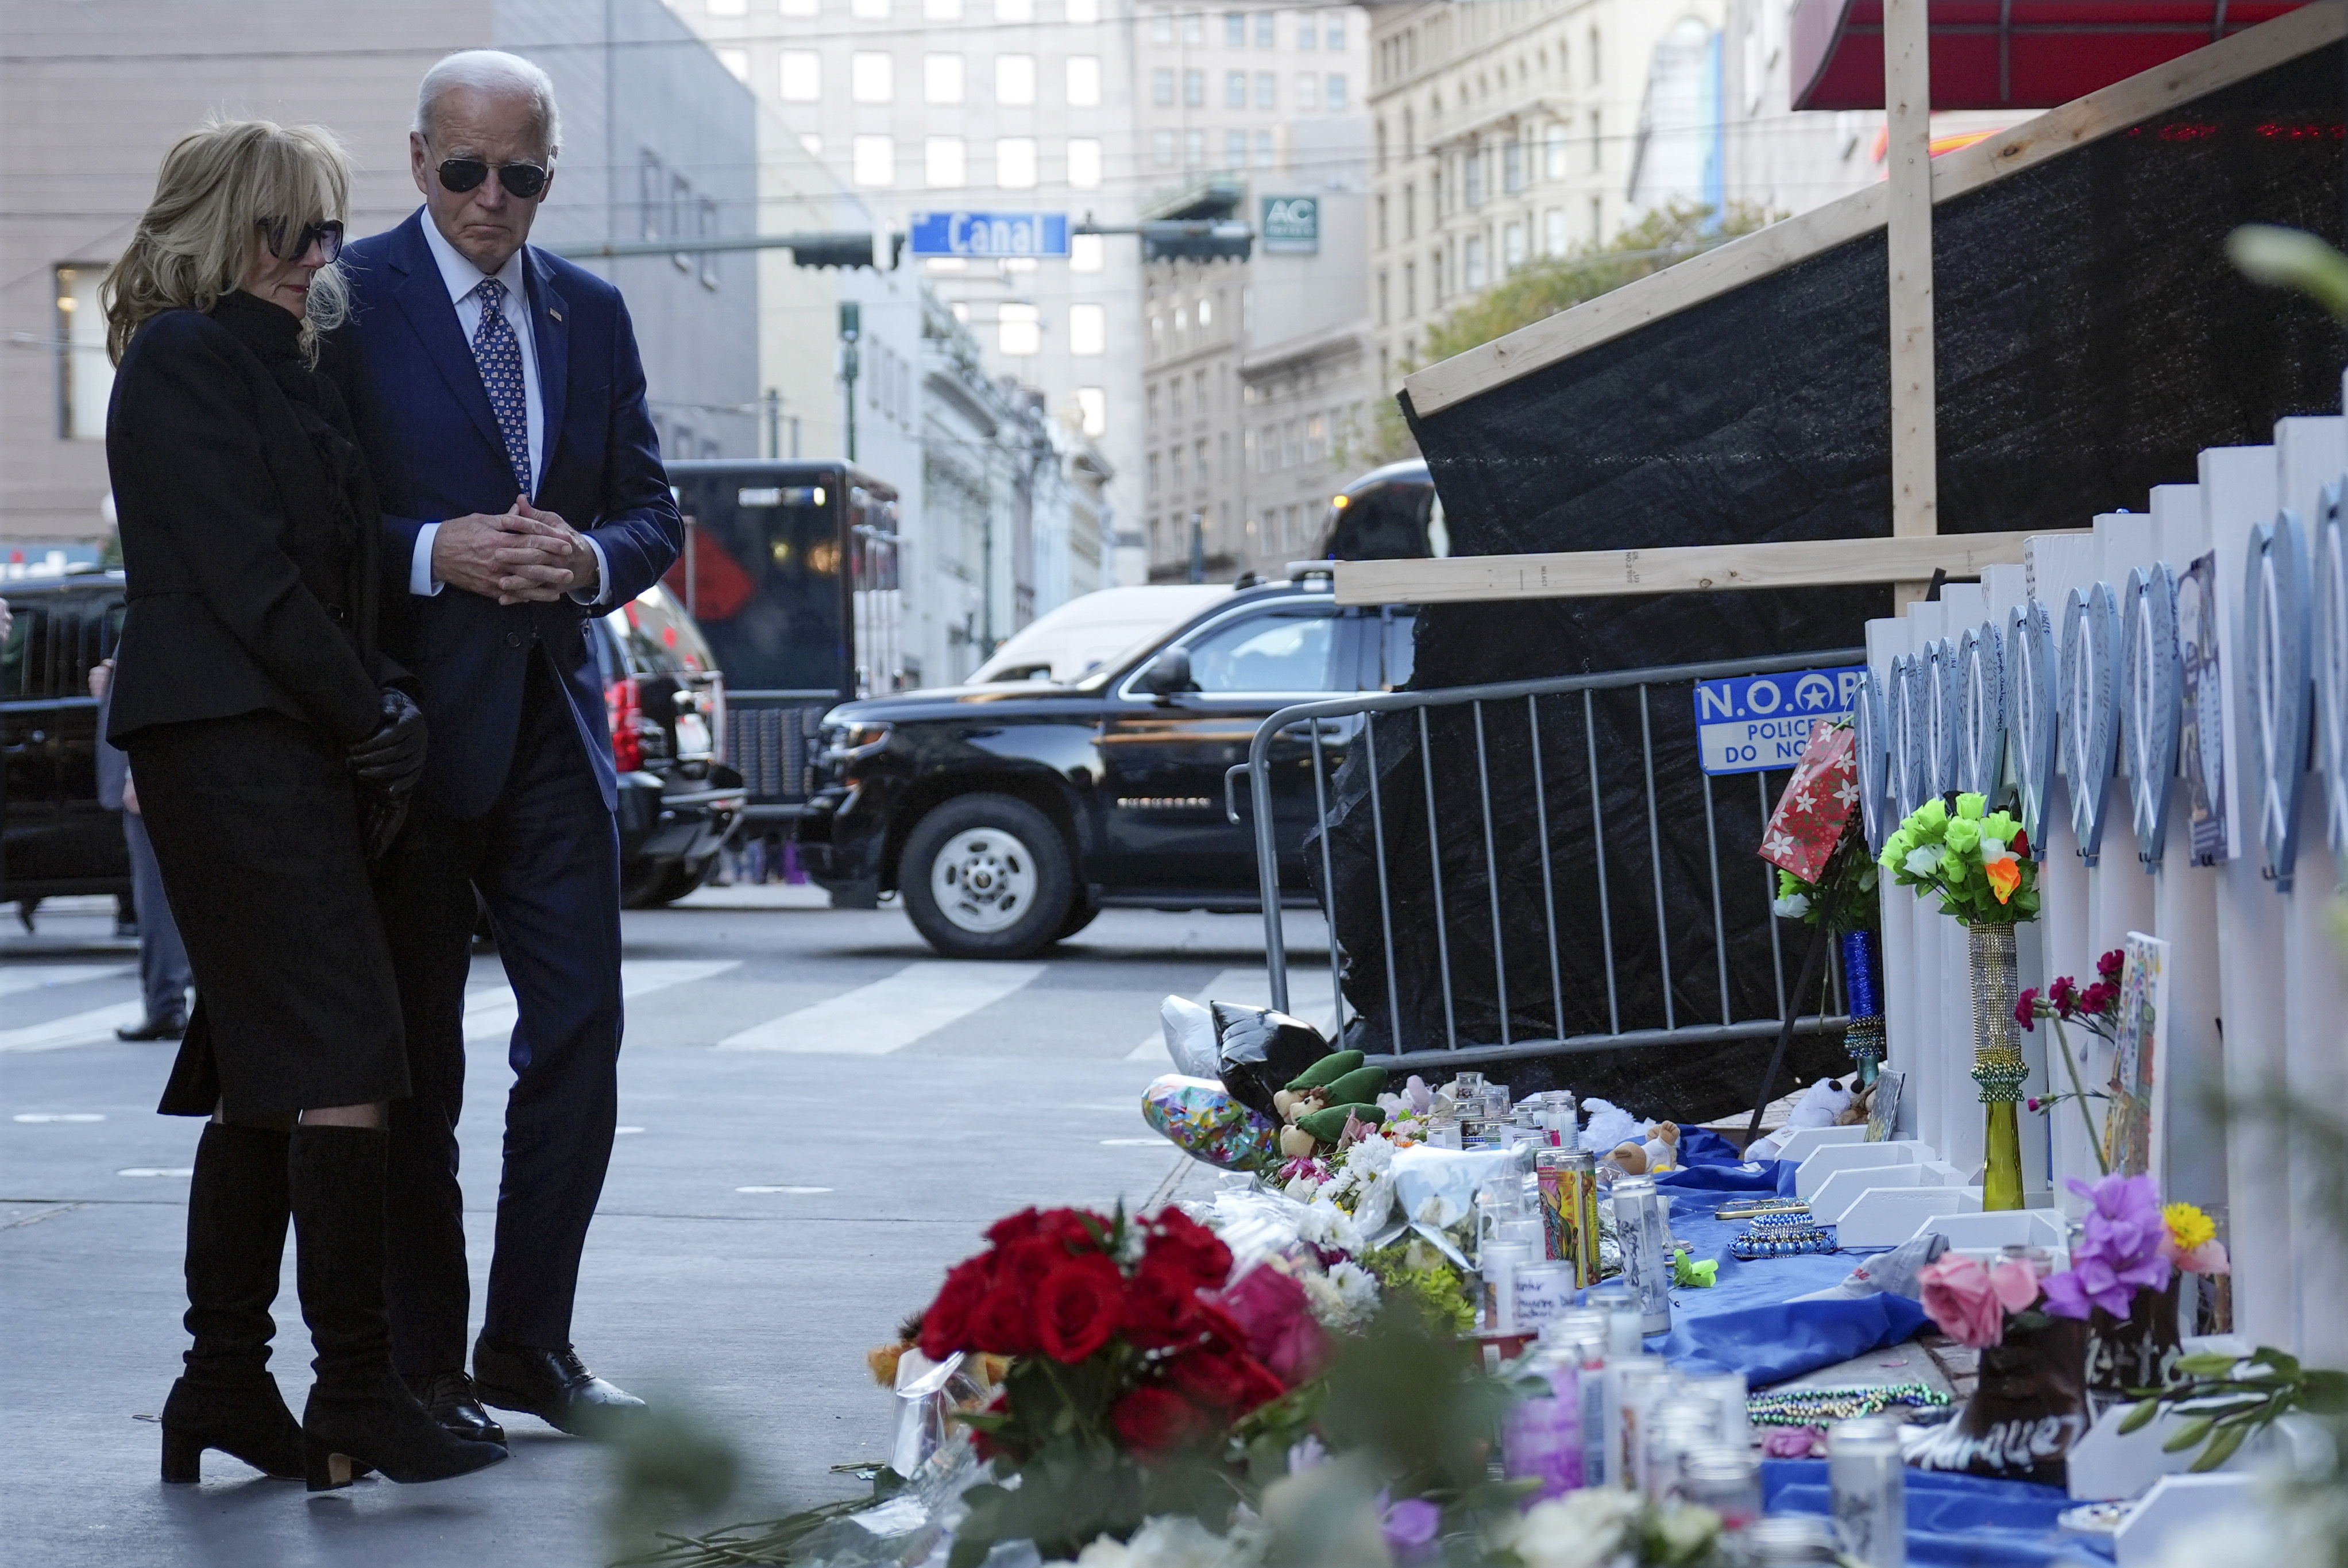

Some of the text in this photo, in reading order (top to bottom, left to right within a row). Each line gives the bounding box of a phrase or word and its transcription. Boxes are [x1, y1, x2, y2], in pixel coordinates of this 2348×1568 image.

[1266, 199, 1315, 223] AC
[948, 210, 1044, 252] Canal
[1748, 719, 1817, 740] POLICE
[1725, 740, 1807, 763] DO NO
